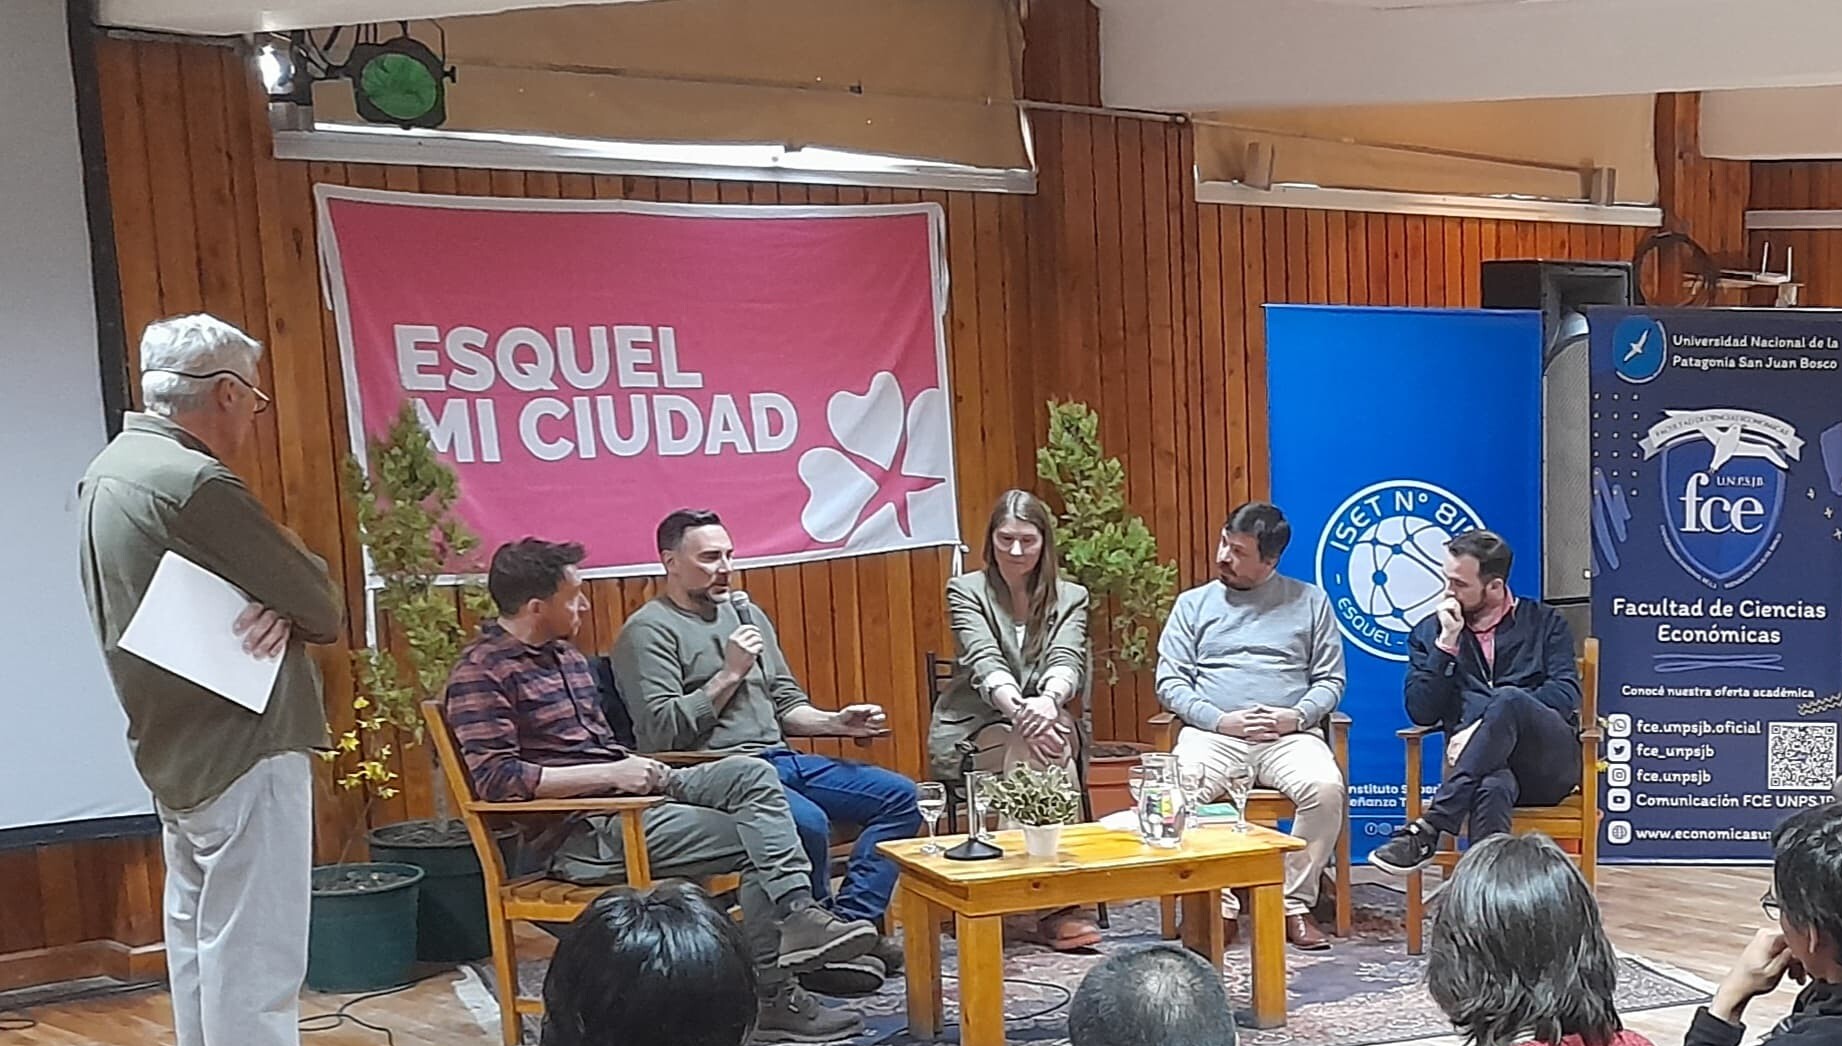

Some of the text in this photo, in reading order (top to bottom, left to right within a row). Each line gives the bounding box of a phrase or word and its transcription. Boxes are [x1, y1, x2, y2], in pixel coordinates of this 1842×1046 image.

[1672, 335, 1839, 349] Universidad Nacional de la
[393, 324, 703, 391] ESQUEL
[1672, 356, 1838, 370] Patagonia San Juan Bosco
[411, 392, 798, 463] MI CIUDAD
[1330, 495, 1382, 551] ISET
[1612, 598, 1826, 619] Facultad de Ciencias
[1338, 597, 1392, 646] ESQUEL
[1657, 623, 1781, 643] Económicas
[1621, 685, 1814, 699] Conocé nuestra oferta académica
[1636, 720, 1762, 737] fce.unpsjb.oficial
[1636, 743, 1715, 761] fce_unpsjb
[1636, 768, 1711, 786] fce.unpsjb
[1347, 783, 1399, 794] nstituto
[1635, 794, 1739, 808] Comunicación
[1743, 795, 1772, 808] FCE
